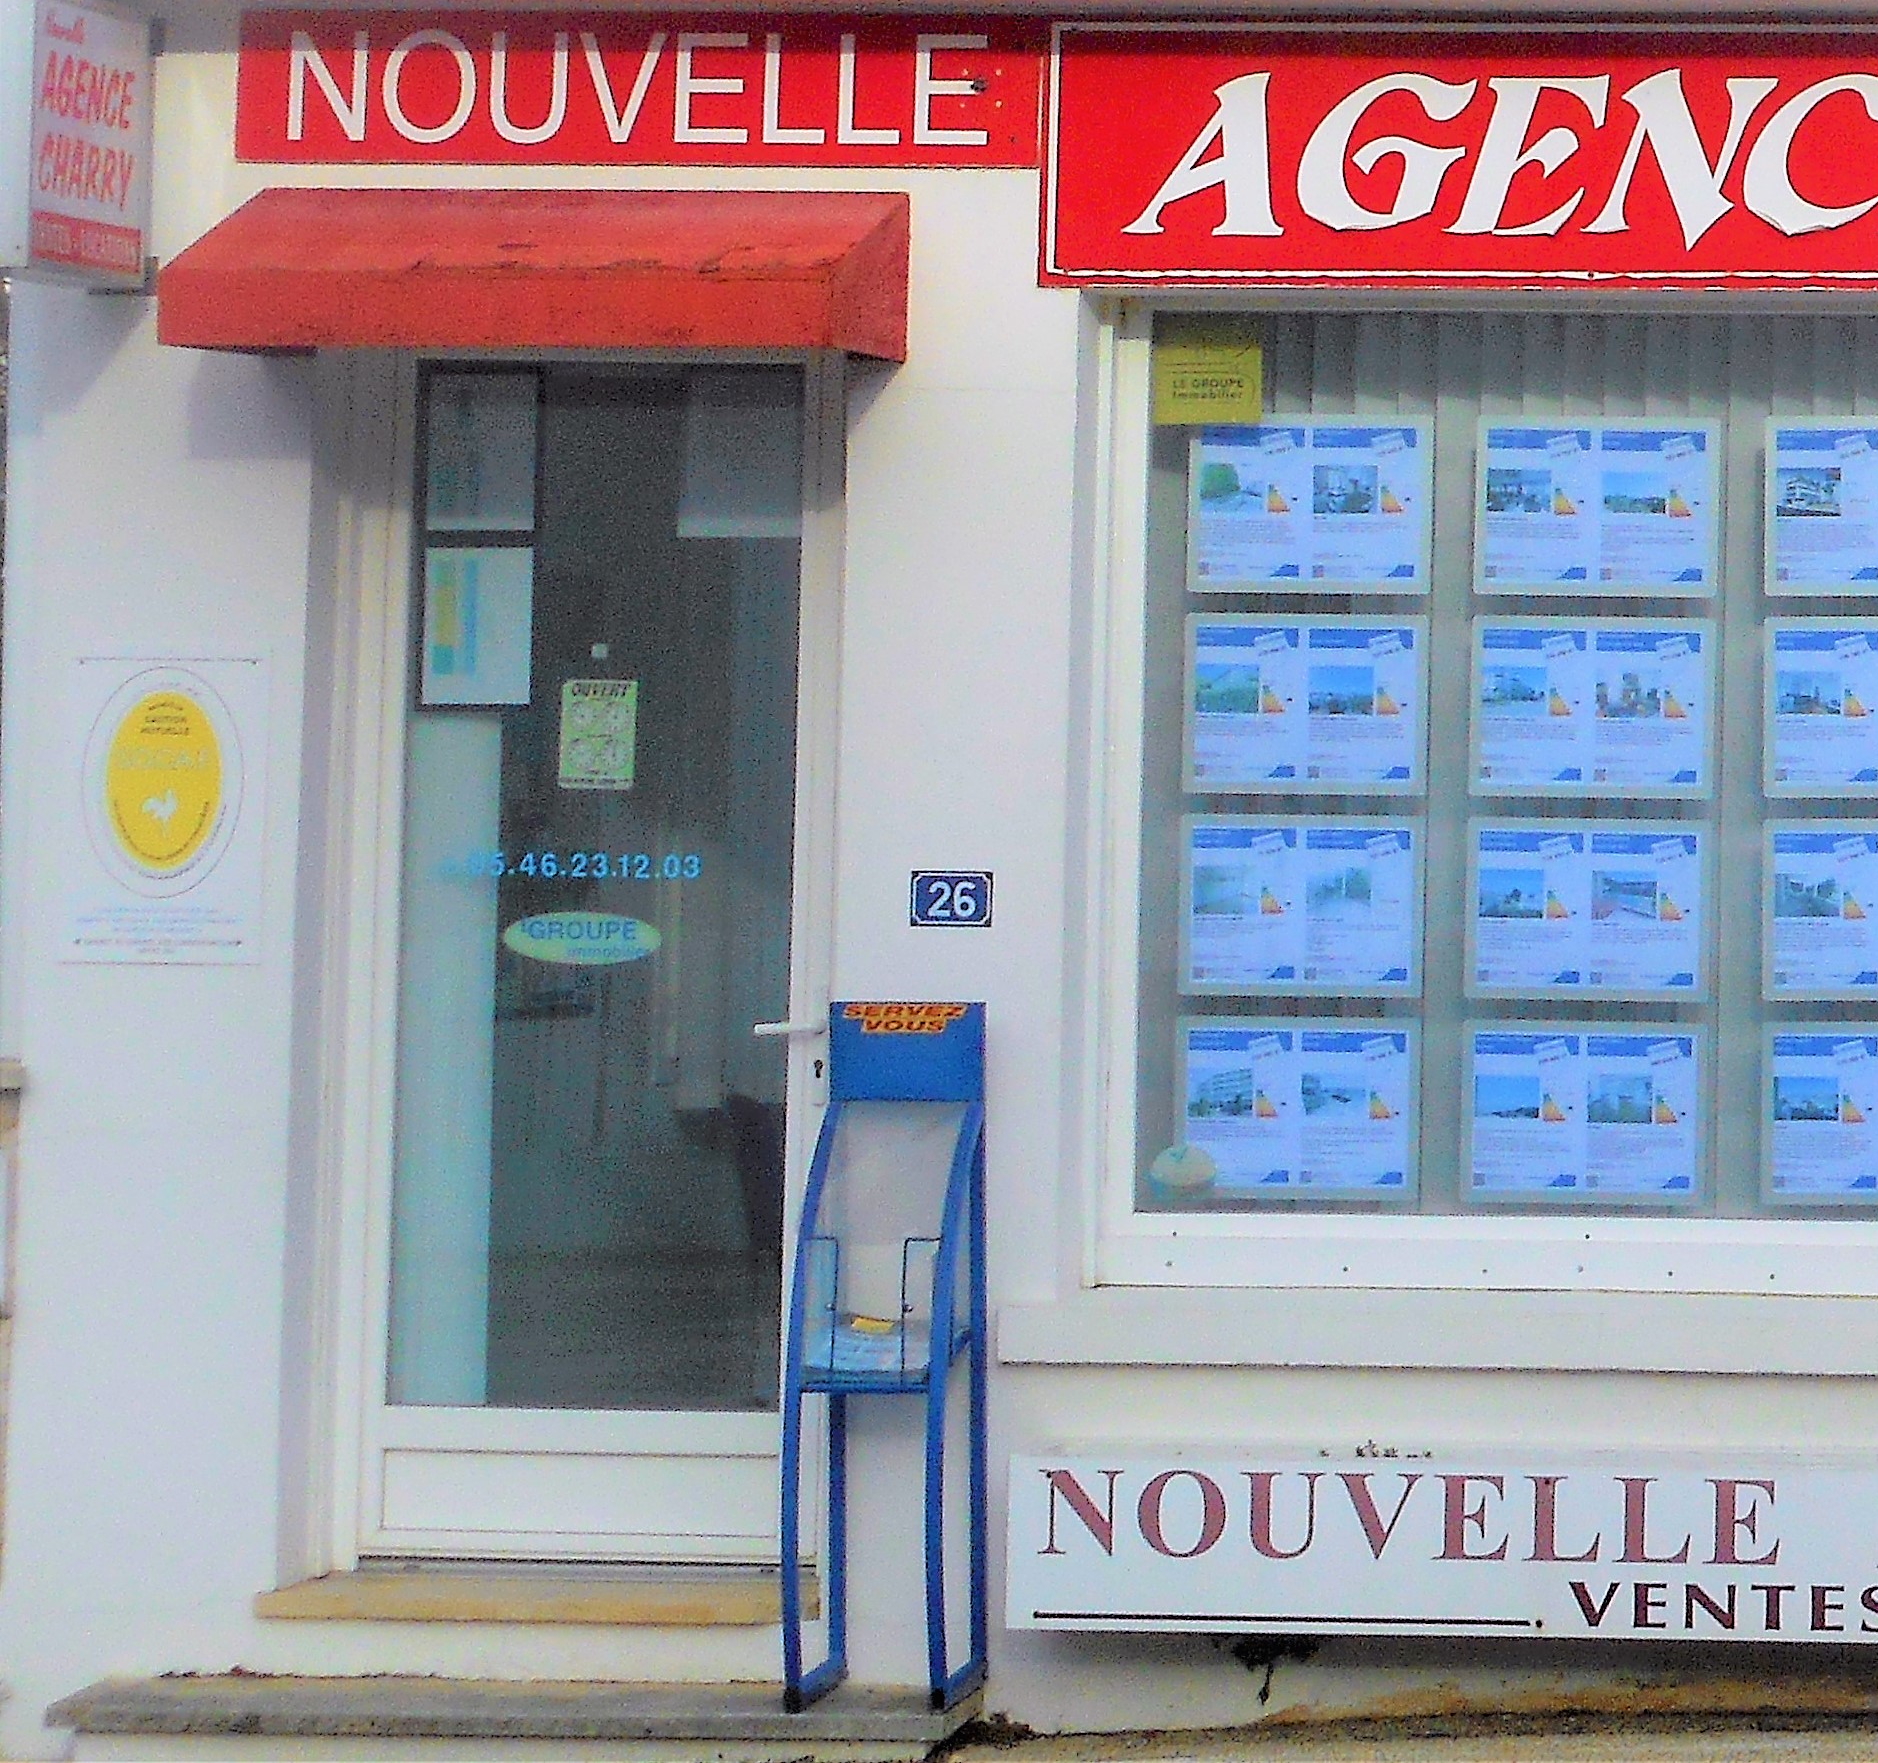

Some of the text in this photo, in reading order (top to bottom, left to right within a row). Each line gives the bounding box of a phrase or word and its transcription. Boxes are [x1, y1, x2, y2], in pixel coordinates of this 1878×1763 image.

[40, 49, 135, 130] AGENCE
[286, 30, 989, 146] NOUVELLE
[37, 132, 136, 212] CHARRY
[927, 880, 977, 918] 26
[527, 920, 638, 941] GROUPE
[845, 1004, 964, 1018] SERVEZ
[865, 1018, 946, 1032] VOUS
[1037, 1468, 1781, 1568] NOUVELLE
